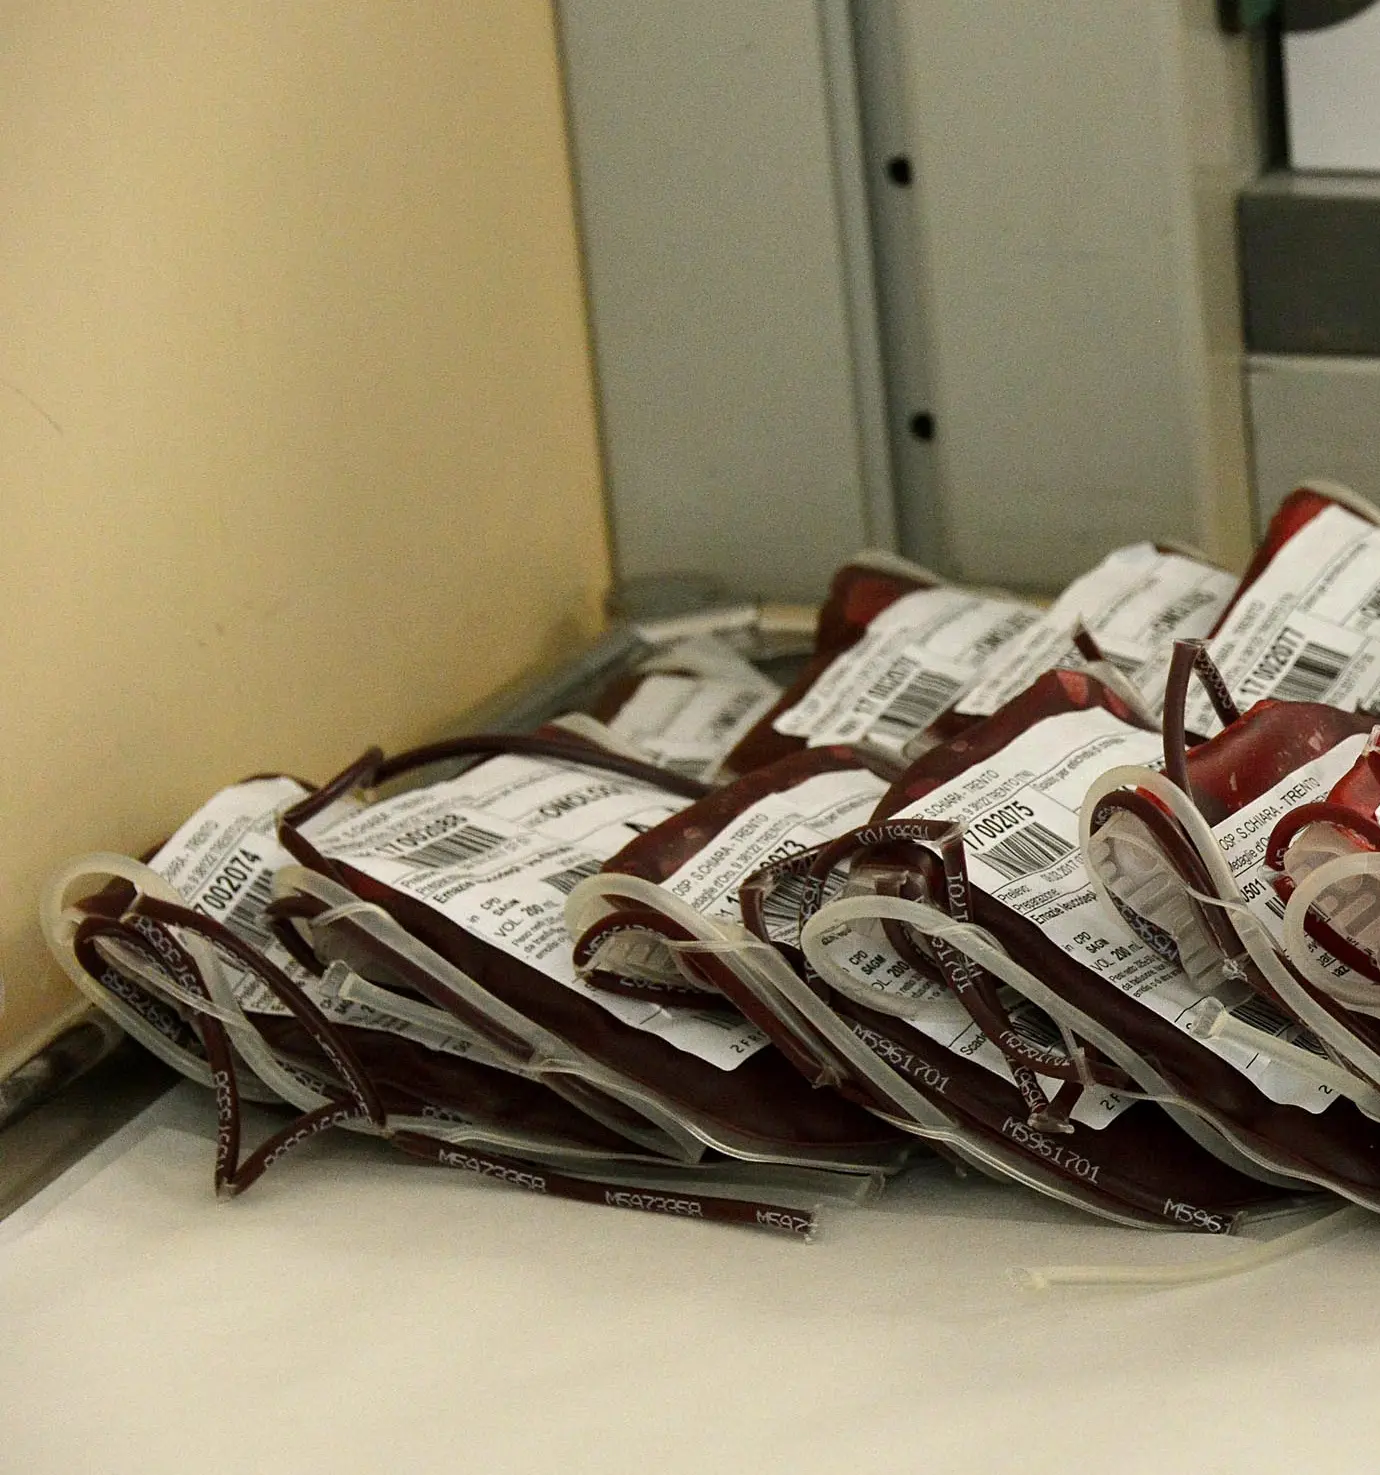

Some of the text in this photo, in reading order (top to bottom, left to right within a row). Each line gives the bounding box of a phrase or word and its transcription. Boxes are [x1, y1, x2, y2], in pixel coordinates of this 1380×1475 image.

[961, 765, 1001, 796] TRENTO
[973, 796, 1036, 842] 002075
[1234, 802, 1282, 841] S.CHIARA
[1279, 774, 1322, 808] TRENTO
[202, 849, 263, 910] 002074
[1071, 929, 1092, 947] CPD
[1083, 934, 1111, 956] SAGM
[847, 947, 868, 968] CPD
[860, 951, 887, 977] SAGM
[885, 956, 911, 982] 200
[852, 1022, 951, 1094] M5961701
[1001, 1117, 1102, 1185] M5961701
